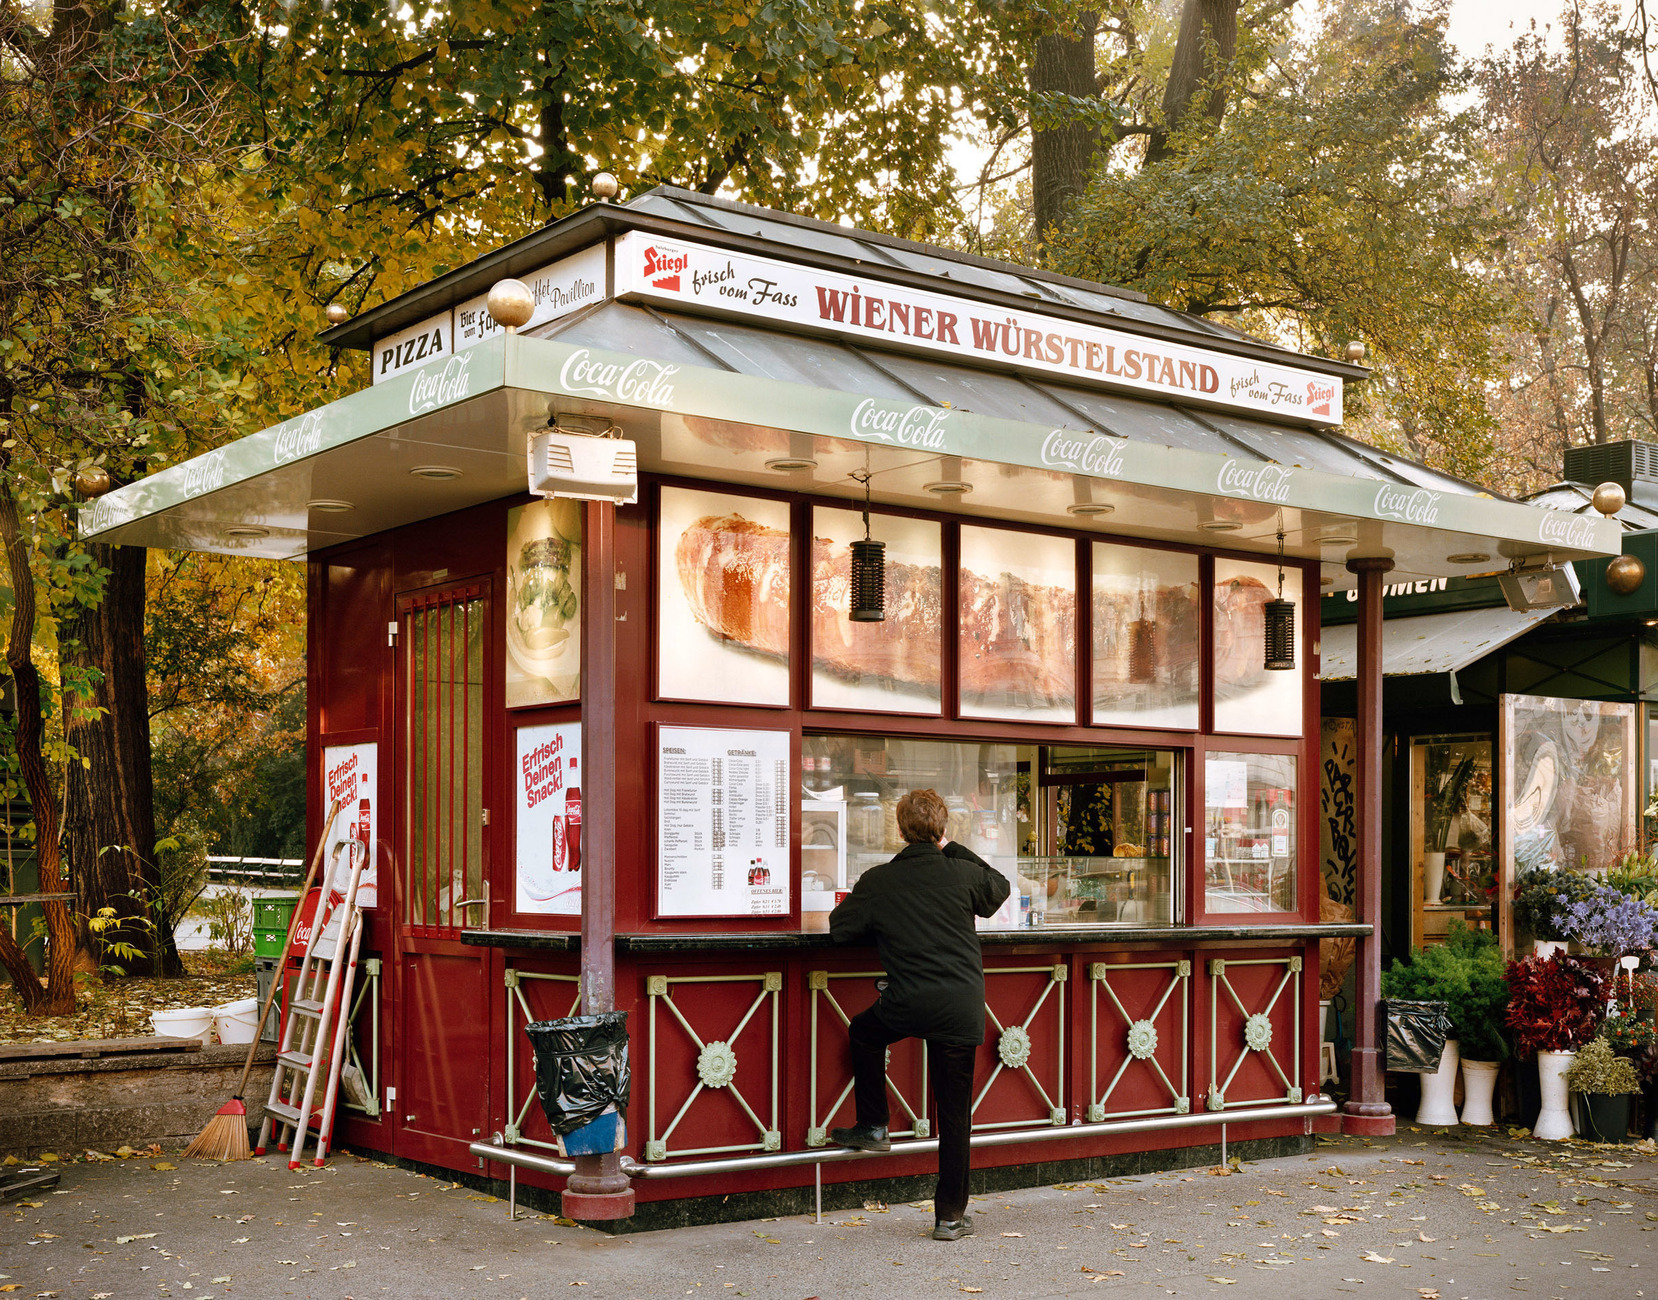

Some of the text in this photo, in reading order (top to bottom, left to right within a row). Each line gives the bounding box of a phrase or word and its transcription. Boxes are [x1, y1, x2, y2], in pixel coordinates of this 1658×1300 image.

[644, 246, 688, 278] Stiegl
[692, 261, 736, 295] frisch
[550, 278, 595, 309] Pavillion
[719, 277, 798, 307] vom Fass
[460, 310, 476, 328] Bier
[381, 328, 443, 375] PIZZA
[970, 317, 1220, 394] WÜRSTELSTAND
[409, 351, 474, 415] Coca-Cola
[560, 349, 681, 406] Coca-Cola
[1230, 369, 1260, 398] frisch
[1248, 382, 1303, 405] vom Fass
[1306, 381, 1335, 406] Stiegl
[274, 411, 323, 464] Coca-Cola
[850, 398, 951, 449] Coca-Cola
[1040, 429, 1128, 476] Coca-Cola
[1217, 459, 1295, 502] Coca-Cola
[1373, 484, 1442, 525] Coca-Cola
[1538, 513, 1597, 548] Coca-Cola
[328, 752, 358, 788] Erfrisch
[522, 733, 563, 775] Erfrisch
[330, 772, 357, 802] Deinen
[524, 756, 562, 792] Deinen
[527, 770, 563, 809] Snack!
[338, 784, 358, 814] nack!
